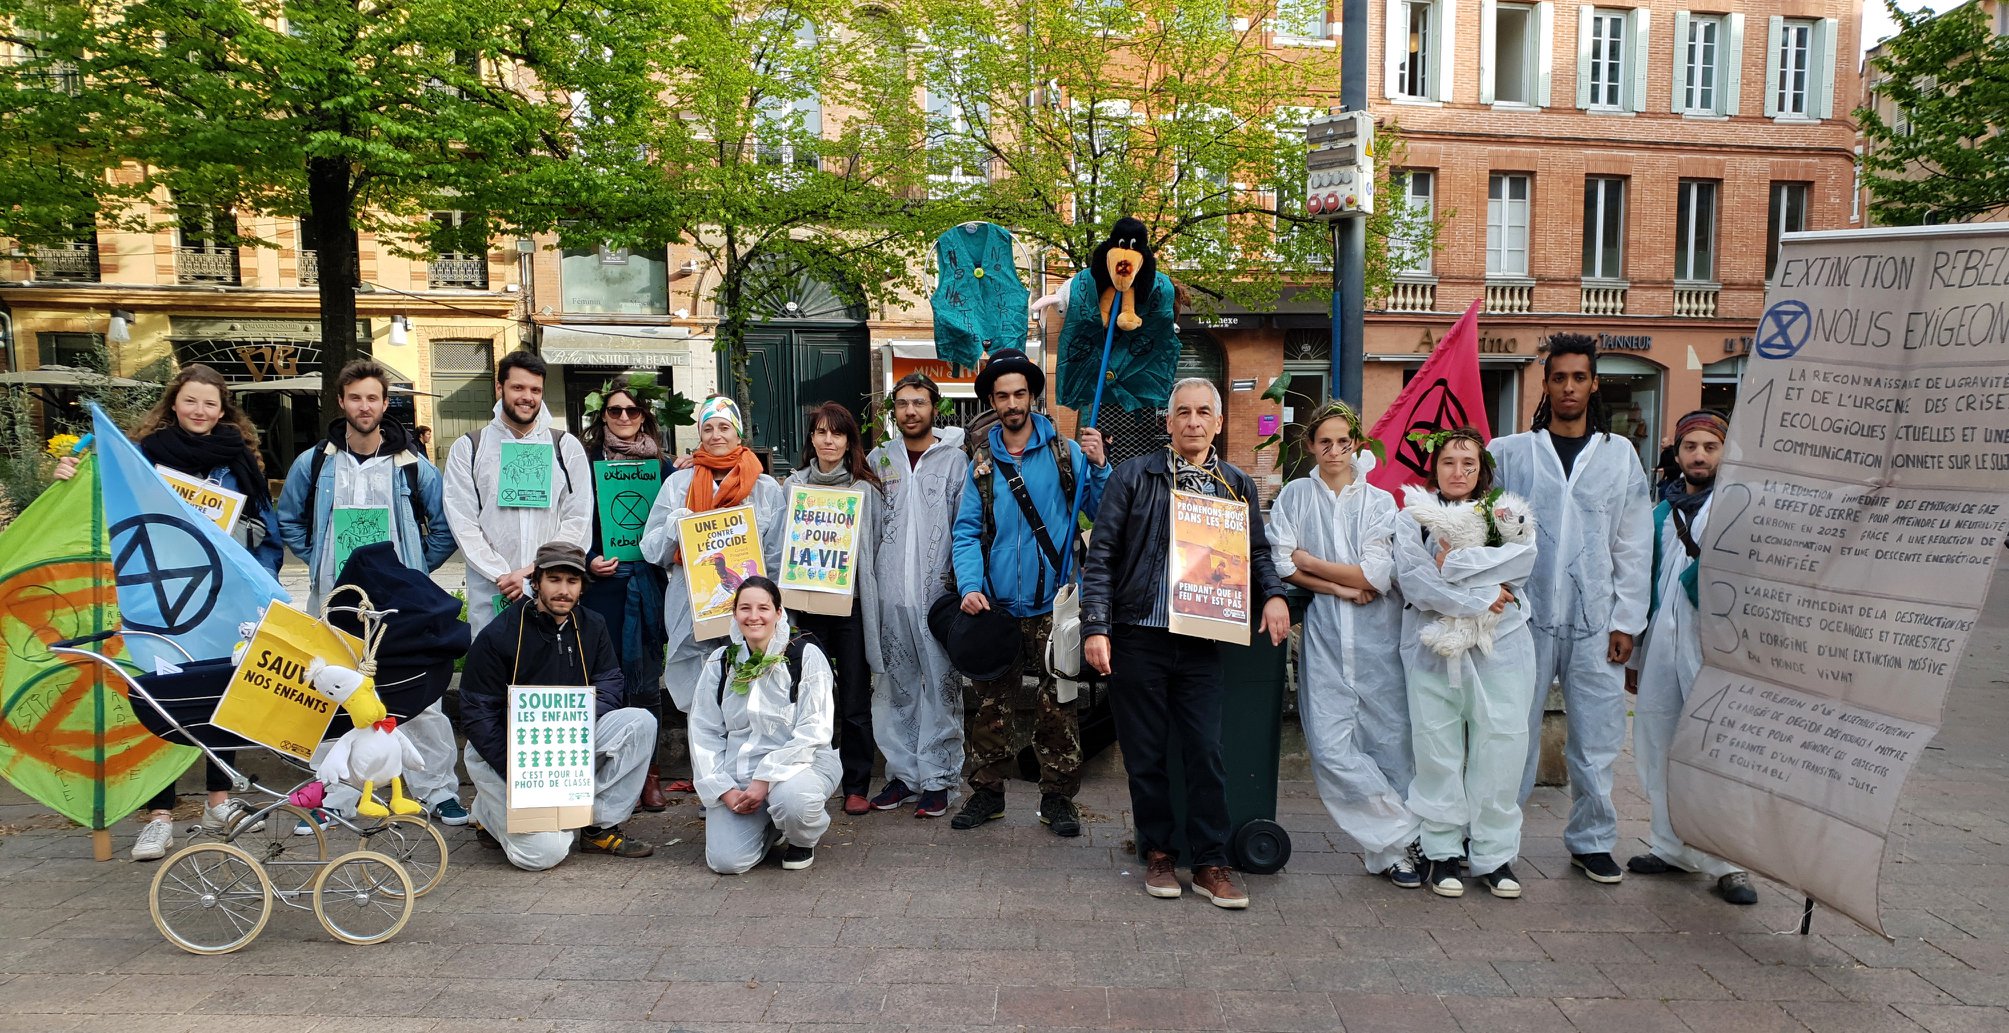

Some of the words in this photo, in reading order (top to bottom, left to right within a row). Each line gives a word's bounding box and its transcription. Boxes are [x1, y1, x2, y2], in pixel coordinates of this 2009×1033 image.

[1813, 308, 1893, 348] NOUS
[1599, 332, 1652, 350] TANNEUR
[588, 354, 630, 364] INSTITUT
[913, 365, 944, 378] MINI
[1788, 367, 1806, 382] LA
[1925, 377, 1942, 389] DE
[1785, 386, 1804, 400] ET
[1811, 389, 1833, 405] DE
[1924, 397, 1949, 414] DES
[1747, 378, 1774, 448] 1
[1962, 426, 1978, 442] ET
[1984, 427, 2009, 444] UNE
[1948, 453, 1972, 470] SUR
[1763, 479, 1777, 494] LA
[1896, 499, 1917, 511] DES
[1961, 503, 1976, 514] DE
[793, 509, 855, 526] REBELLION
[1178, 511, 1202, 524] DANS
[1206, 516, 1220, 527] LES
[1224, 519, 1244, 532] BOIS
[1714, 483, 1751, 555] 2
[1774, 498, 1806, 514] EFFET
[1809, 505, 1825, 518] DE
[1825, 508, 1862, 523] SERRE
[1868, 513, 1890, 525] POUR
[1939, 519, 1951, 529] LA
[695, 519, 718, 533] UNE
[724, 514, 743, 527] LOI
[1752, 515, 1796, 530] CARBONE
[1801, 524, 1812, 534] EN
[1817, 526, 1847, 539] 2025
[1908, 534, 1927, 545] UNE
[1980, 537, 1997, 547] DE
[707, 528, 735, 539] CONTRE
[805, 529, 838, 543] POUR
[697, 535, 748, 552] L'ÉCOCIDE
[1750, 533, 1763, 543] LA
[1840, 546, 1853, 556] ET
[789, 546, 812, 567] LA
[818, 548, 849, 570] VIE
[1178, 582, 1214, 596] PENDANT
[1216, 588, 1232, 598] QUE
[1234, 590, 1243, 600] LE
[1178, 591, 1193, 602] FEU
[1211, 596, 1225, 606] EST
[1227, 598, 1242, 609] PAS
[1711, 581, 1739, 654] 3
[1859, 606, 1873, 618] DE
[1879, 630, 1890, 642] ET
[1771, 656, 1807, 675] MONDE
[243, 669, 272, 690] NOS
[273, 682, 328, 714] ENFANTS
[1738, 684, 1755, 696] LA
[518, 693, 586, 709] SOURIEZ
[517, 711, 535, 723] LES
[542, 711, 589, 723] ENFANTS
[1690, 683, 1731, 752] 4
[1720, 716, 1736, 729] EN
[1767, 729, 1794, 743] POUR
[514, 780, 544, 789] PHOTO
[549, 779, 560, 788] DE
[564, 778, 591, 787] CLASSE
[522, 770, 543, 780] C'EST
[548, 770, 570, 779] POUR
[574, 769, 584, 778] LA
